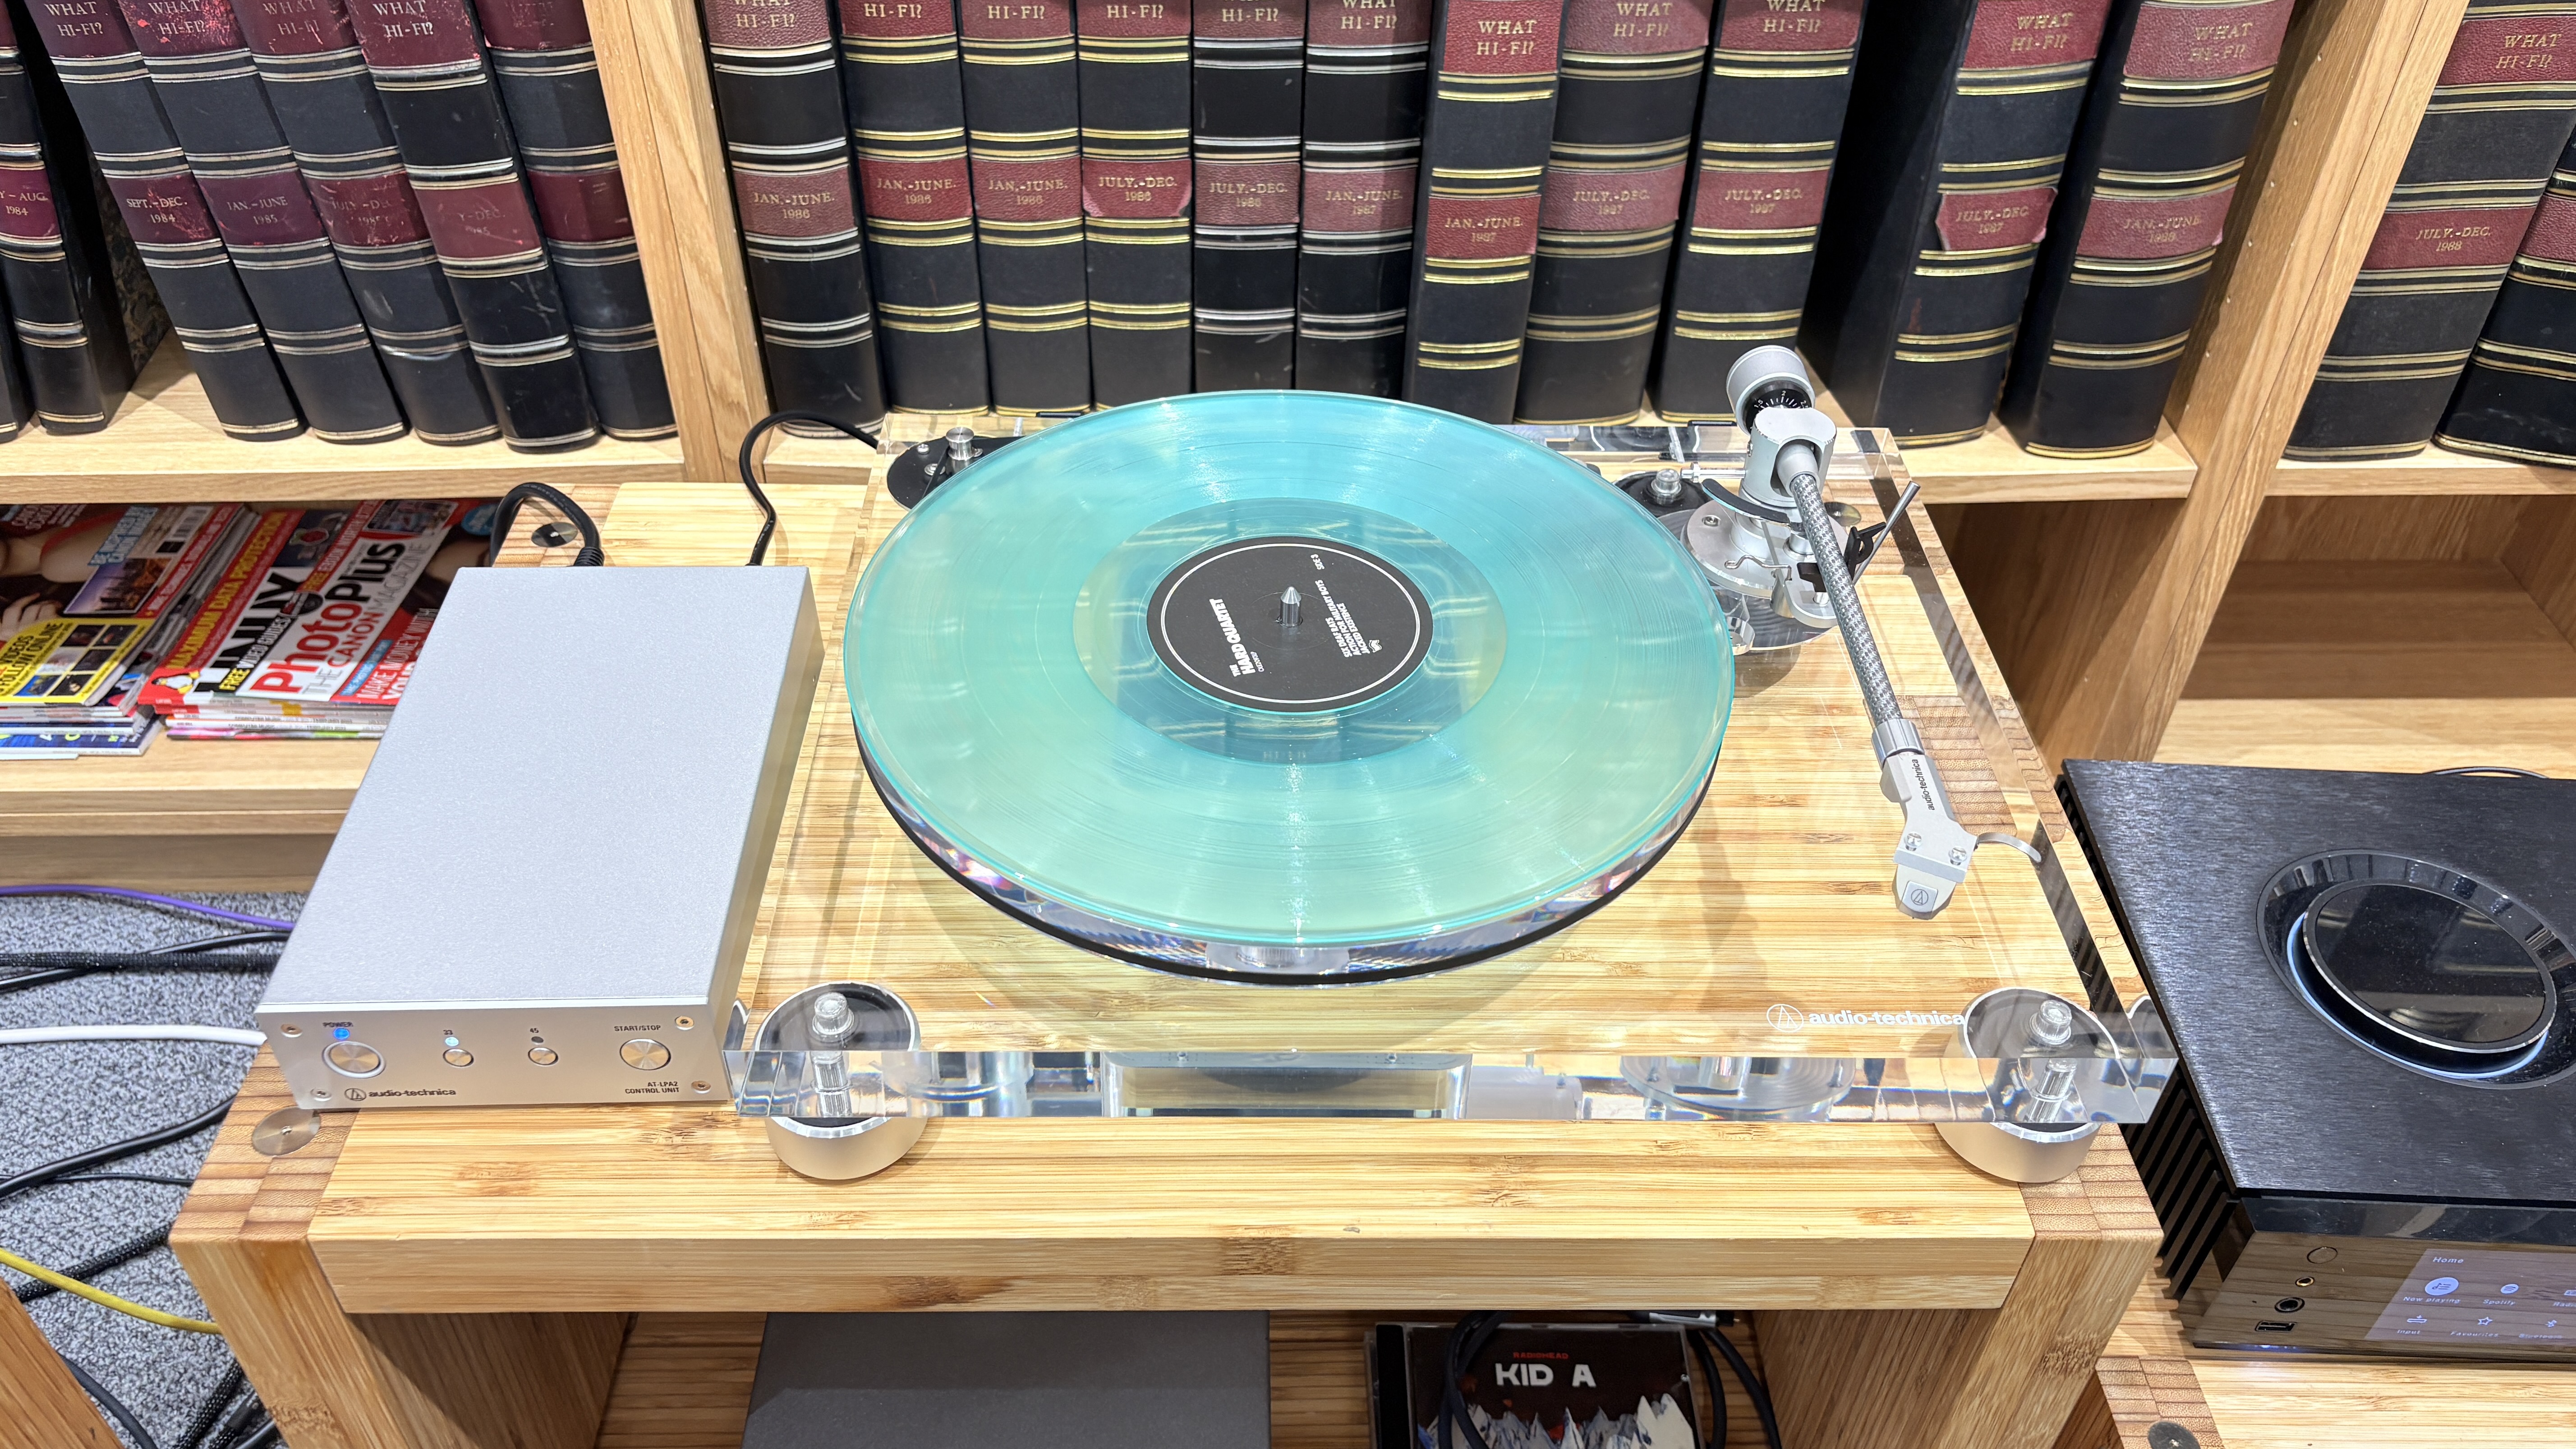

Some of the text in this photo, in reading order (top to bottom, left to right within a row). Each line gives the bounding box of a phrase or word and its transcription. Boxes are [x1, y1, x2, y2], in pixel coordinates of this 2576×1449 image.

[44, 1, 97, 16] WHAT
[148, 0, 203, 14] WHAT
[373, 0, 426, 16] WHAT
[865, 3, 922, 18] HI-FI?
[988, 5, 1045, 20] HI-FI?
[1107, 5, 1164, 19] HI-FI?
[1617, 3, 1673, 17] WHAT
[1767, 0, 1826, 13] WHAT
[736, 13, 795, 28] HI-FI?
[1222, 9, 1279, 23] HI-FI?
[1340, 16, 1397, 30] HI-FI?
[2016, 13, 2074, 30] WHAT
[57, 23, 103, 37] HI-FI?
[158, 20, 206, 35] HI-FI?
[384, 22, 434, 37] HI-FI?
[1478, 20, 1537, 35] WHAT
[1763, 18, 1821, 33] HI-FI?
[2194, 23, 2254, 41] WHAT
[2010, 34, 2068, 52] HI-FI?
[2505, 34, 2562, 48] WHAT
[877, 178, 956, 191] JAN.-JUNE.
[988, 179, 1068, 191] JAN.-JUNE.
[1098, 177, 1178, 189] JULY.-DEC.
[1209, 183, 1288, 194] JULY.-DEC.
[754, 193, 835, 206] JAN.-JUNE.
[905, 194, 931, 205] 1986
[1016, 195, 1043, 205] 1986
[1125, 192, 1152, 202] 1986
[1325, 190, 1403, 202] JAN.-JUNE.
[1573, 190, 1650, 203] JULY.-DEC.
[1725, 189, 1803, 202] JULY.-DEC.
[127, 198, 188, 208] SEPT.-DEC.
[1236, 198, 1261, 208] 1986
[1598, 204, 1624, 216] 1987
[1750, 203, 1776, 214] 1987
[6, 206, 28, 216] 1984
[150, 213, 175, 223] 1984
[783, 209, 810, 220] 1986
[1353, 206, 1376, 216] 1987
[1978, 222, 2004, 235] 1987
[2415, 227, 2492, 240] JULY.-DEC.
[1471, 232, 1497, 243] 1987
[2436, 241, 2462, 252] 1988
[1754, 399, 1763, 408] 1.5
[1313, 558, 1325, 570] SIDE
[302, 669, 343, 694] THE
[328, 612, 384, 667] CANON
[373, 541, 432, 617] MAGAZINE
[1315, 580, 1362, 655] ACTION FOR MILITARY BOYS
[1337, 603, 1370, 654] JACKED EXISTENCE
[1209, 598, 1256, 674] HARD QUARTET
[1325, 617, 1352, 658] SIX DEAF RATS
[219, 668, 250, 690] FREE
[236, 644, 271, 668] VIDEO
[356, 671, 398, 699] MAKE
[379, 633, 422, 671] MONEY
[1229, 664, 1241, 677] THE
[1911, 759, 1935, 810] audio-technica
[1808, 1010, 1966, 1025] audio-technica
[369, 1089, 456, 1098] audio-technica
[1495, 1363, 1596, 1388] KID A
